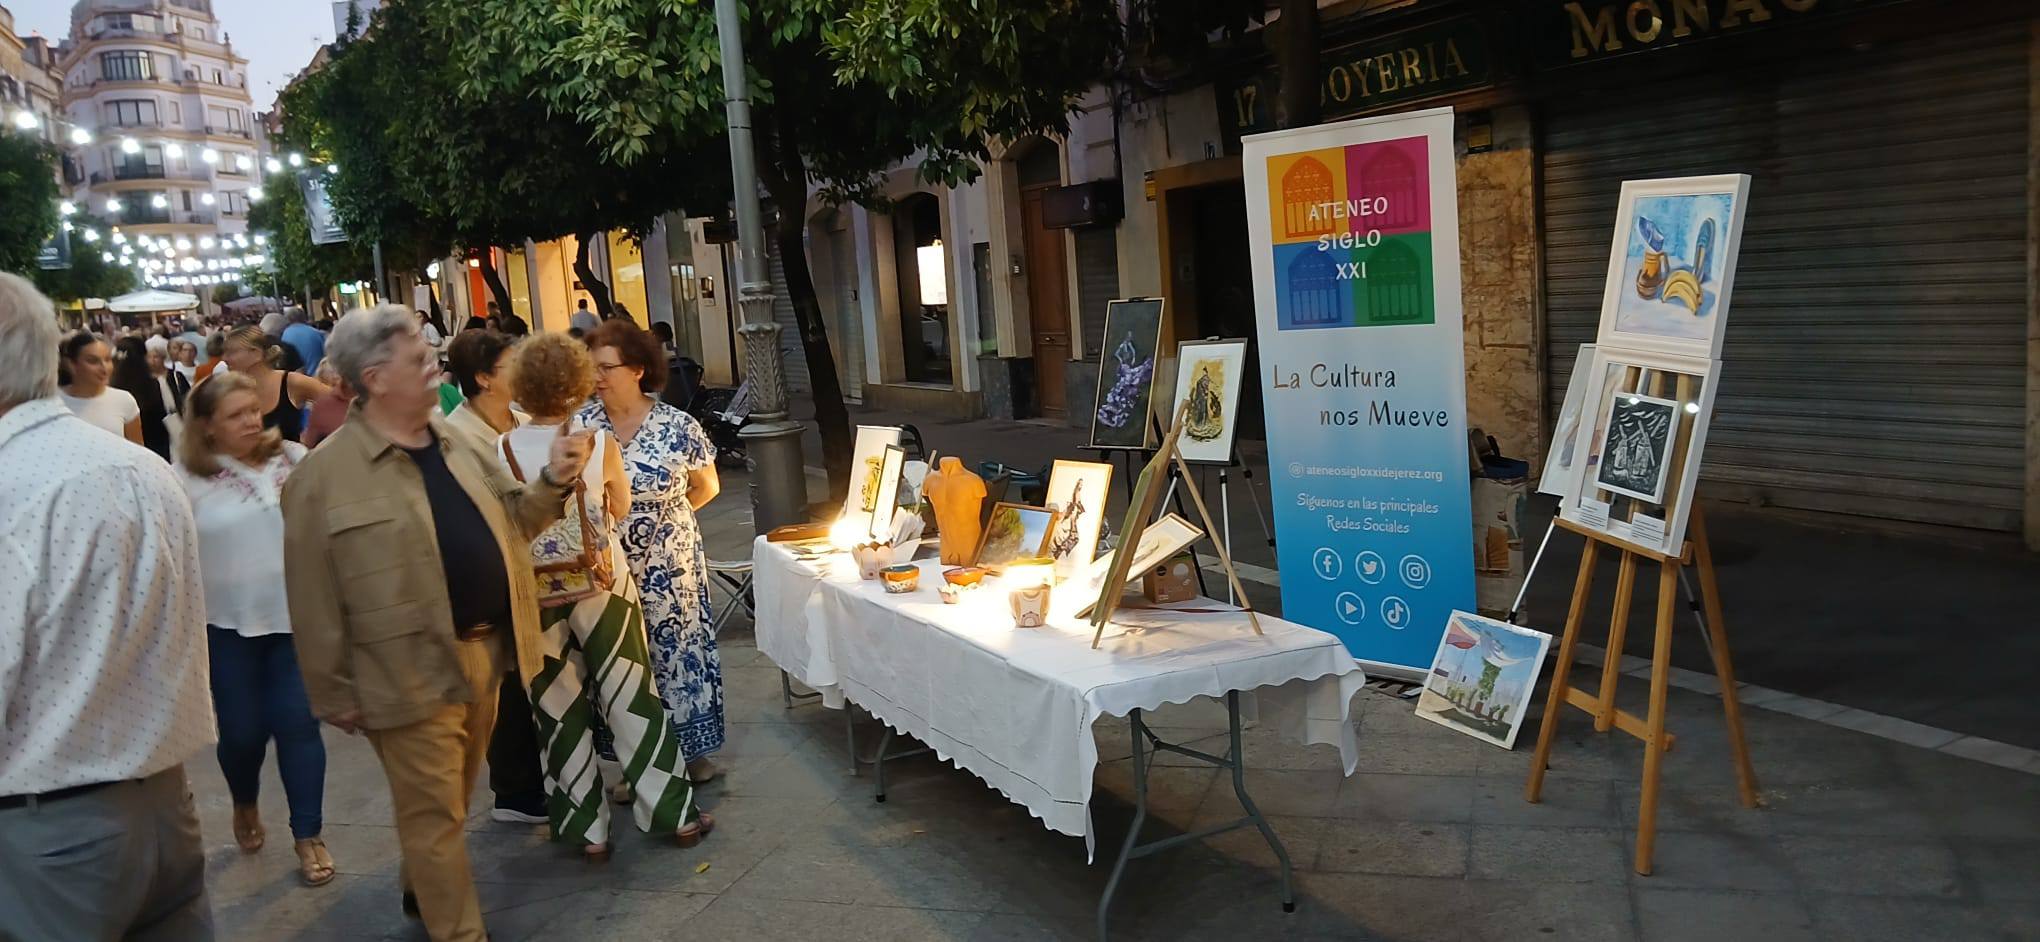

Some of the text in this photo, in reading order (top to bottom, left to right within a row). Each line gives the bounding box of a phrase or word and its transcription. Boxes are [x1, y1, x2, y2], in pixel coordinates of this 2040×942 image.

[1563, 0, 1819, 58] MONA
[1308, 196, 1389, 222] ATENEO
[1317, 229, 1381, 252] SIGLO
[1335, 261, 1367, 280] XXI
[1273, 363, 1396, 389] La Cultura
[1320, 400, 1449, 427] nos Mueve
[1347, 499, 1360, 509] en
[1362, 497, 1377, 510] las
[1380, 497, 1439, 516] principales
[1327, 515, 1410, 534] Redes Sociales
